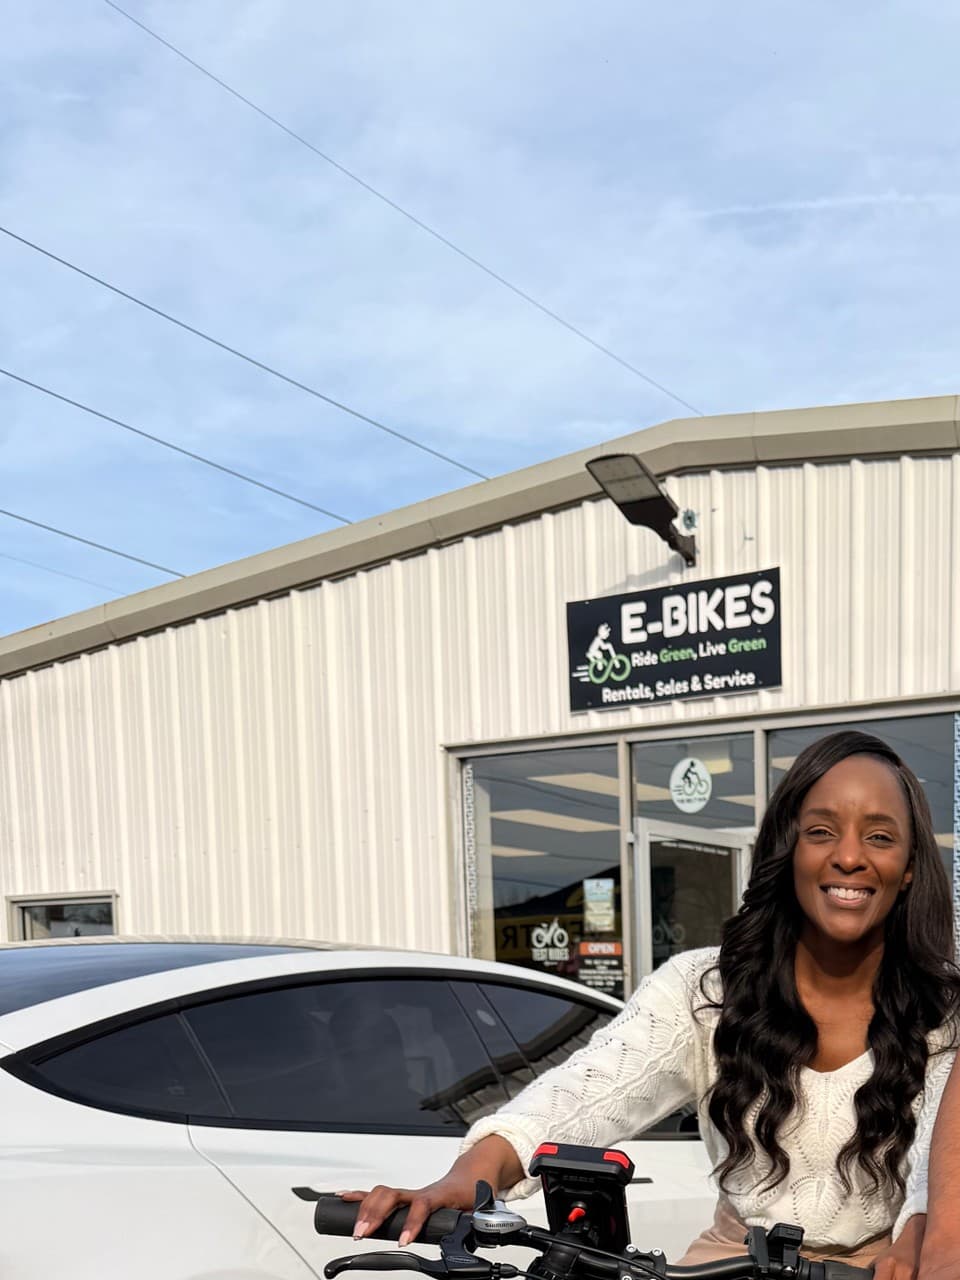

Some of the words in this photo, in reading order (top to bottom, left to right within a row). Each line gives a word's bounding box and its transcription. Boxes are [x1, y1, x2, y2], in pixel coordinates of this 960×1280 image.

[621, 580, 775, 644] E-BIKES
[631, 652, 658, 668] Ride
[659, 648, 698, 663] Green,
[699, 642, 727, 657] Live
[728, 637, 767, 654] Green
[602, 683, 655, 703] Rentals,
[656, 676, 689, 696] Sales
[690, 675, 703, 692] &
[704, 670, 756, 690] Service
[588, 943, 616, 954] OPEN
